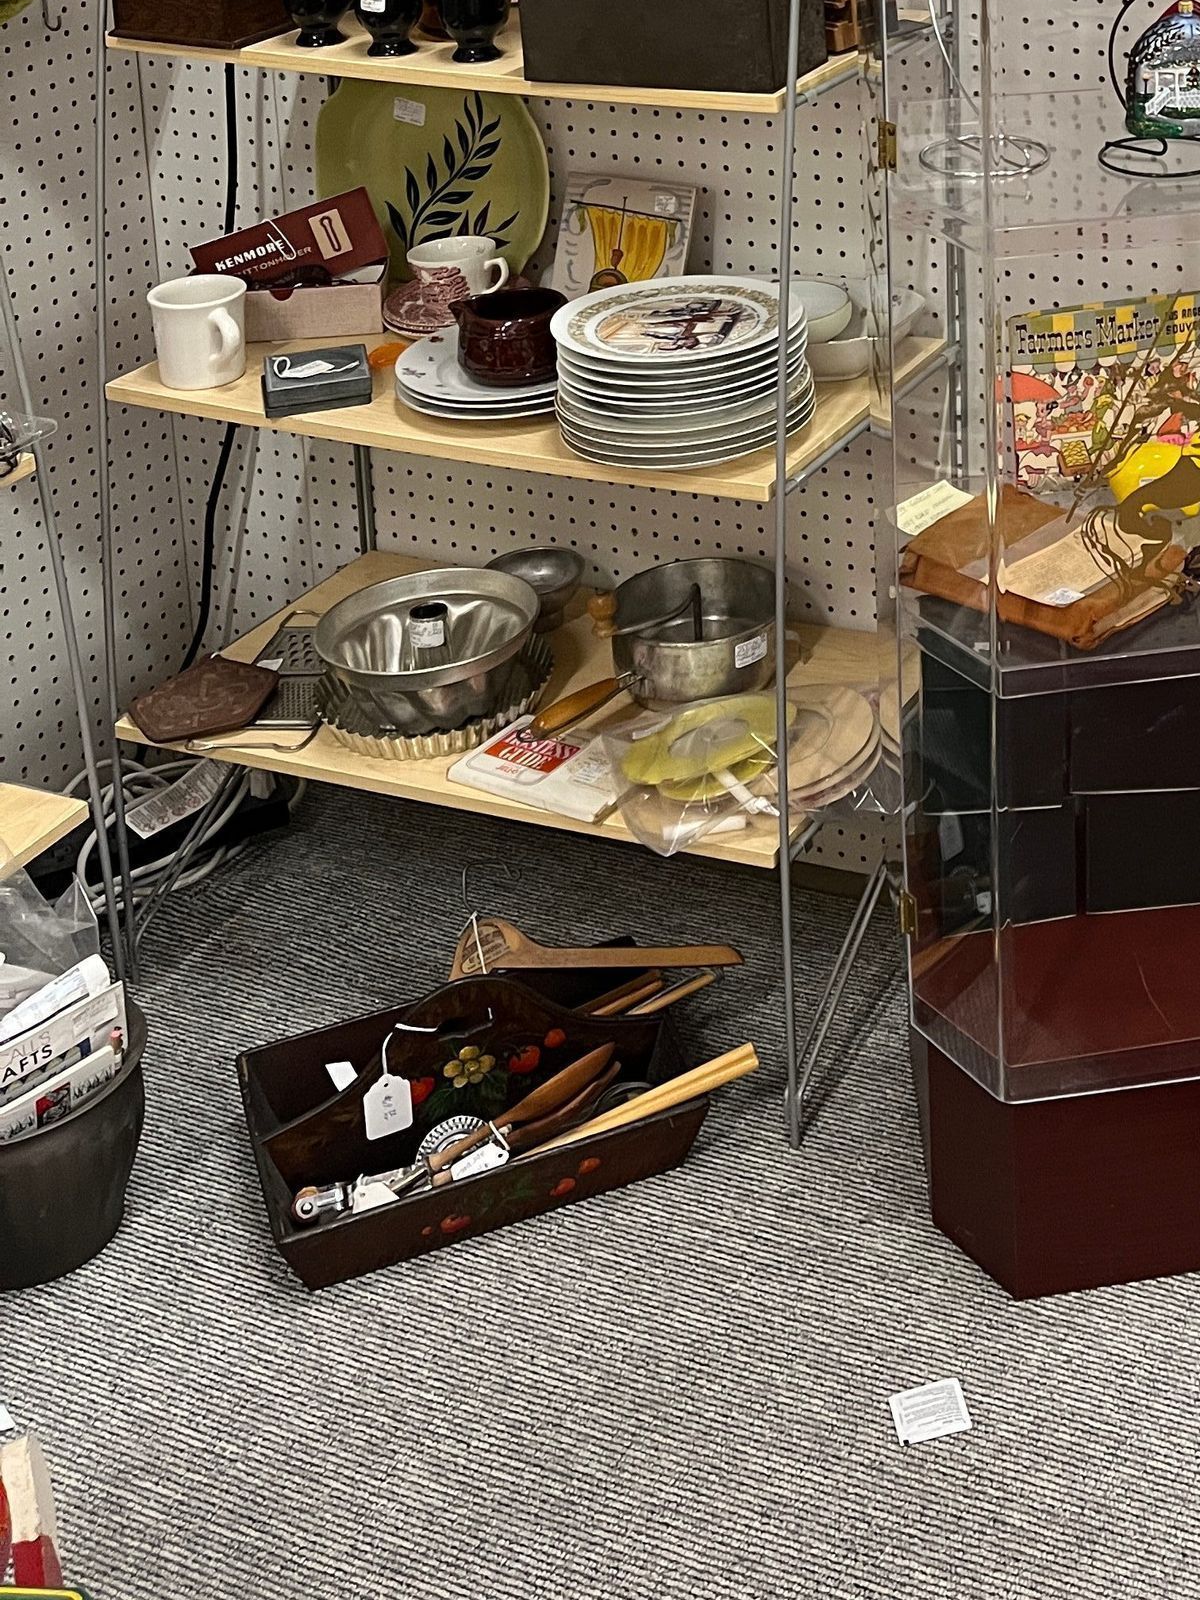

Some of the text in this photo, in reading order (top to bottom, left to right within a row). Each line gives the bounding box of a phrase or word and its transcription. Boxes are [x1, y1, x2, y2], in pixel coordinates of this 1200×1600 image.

[214, 239, 286, 272] KENMORE
[1015, 311, 1160, 355] Farmers Market
